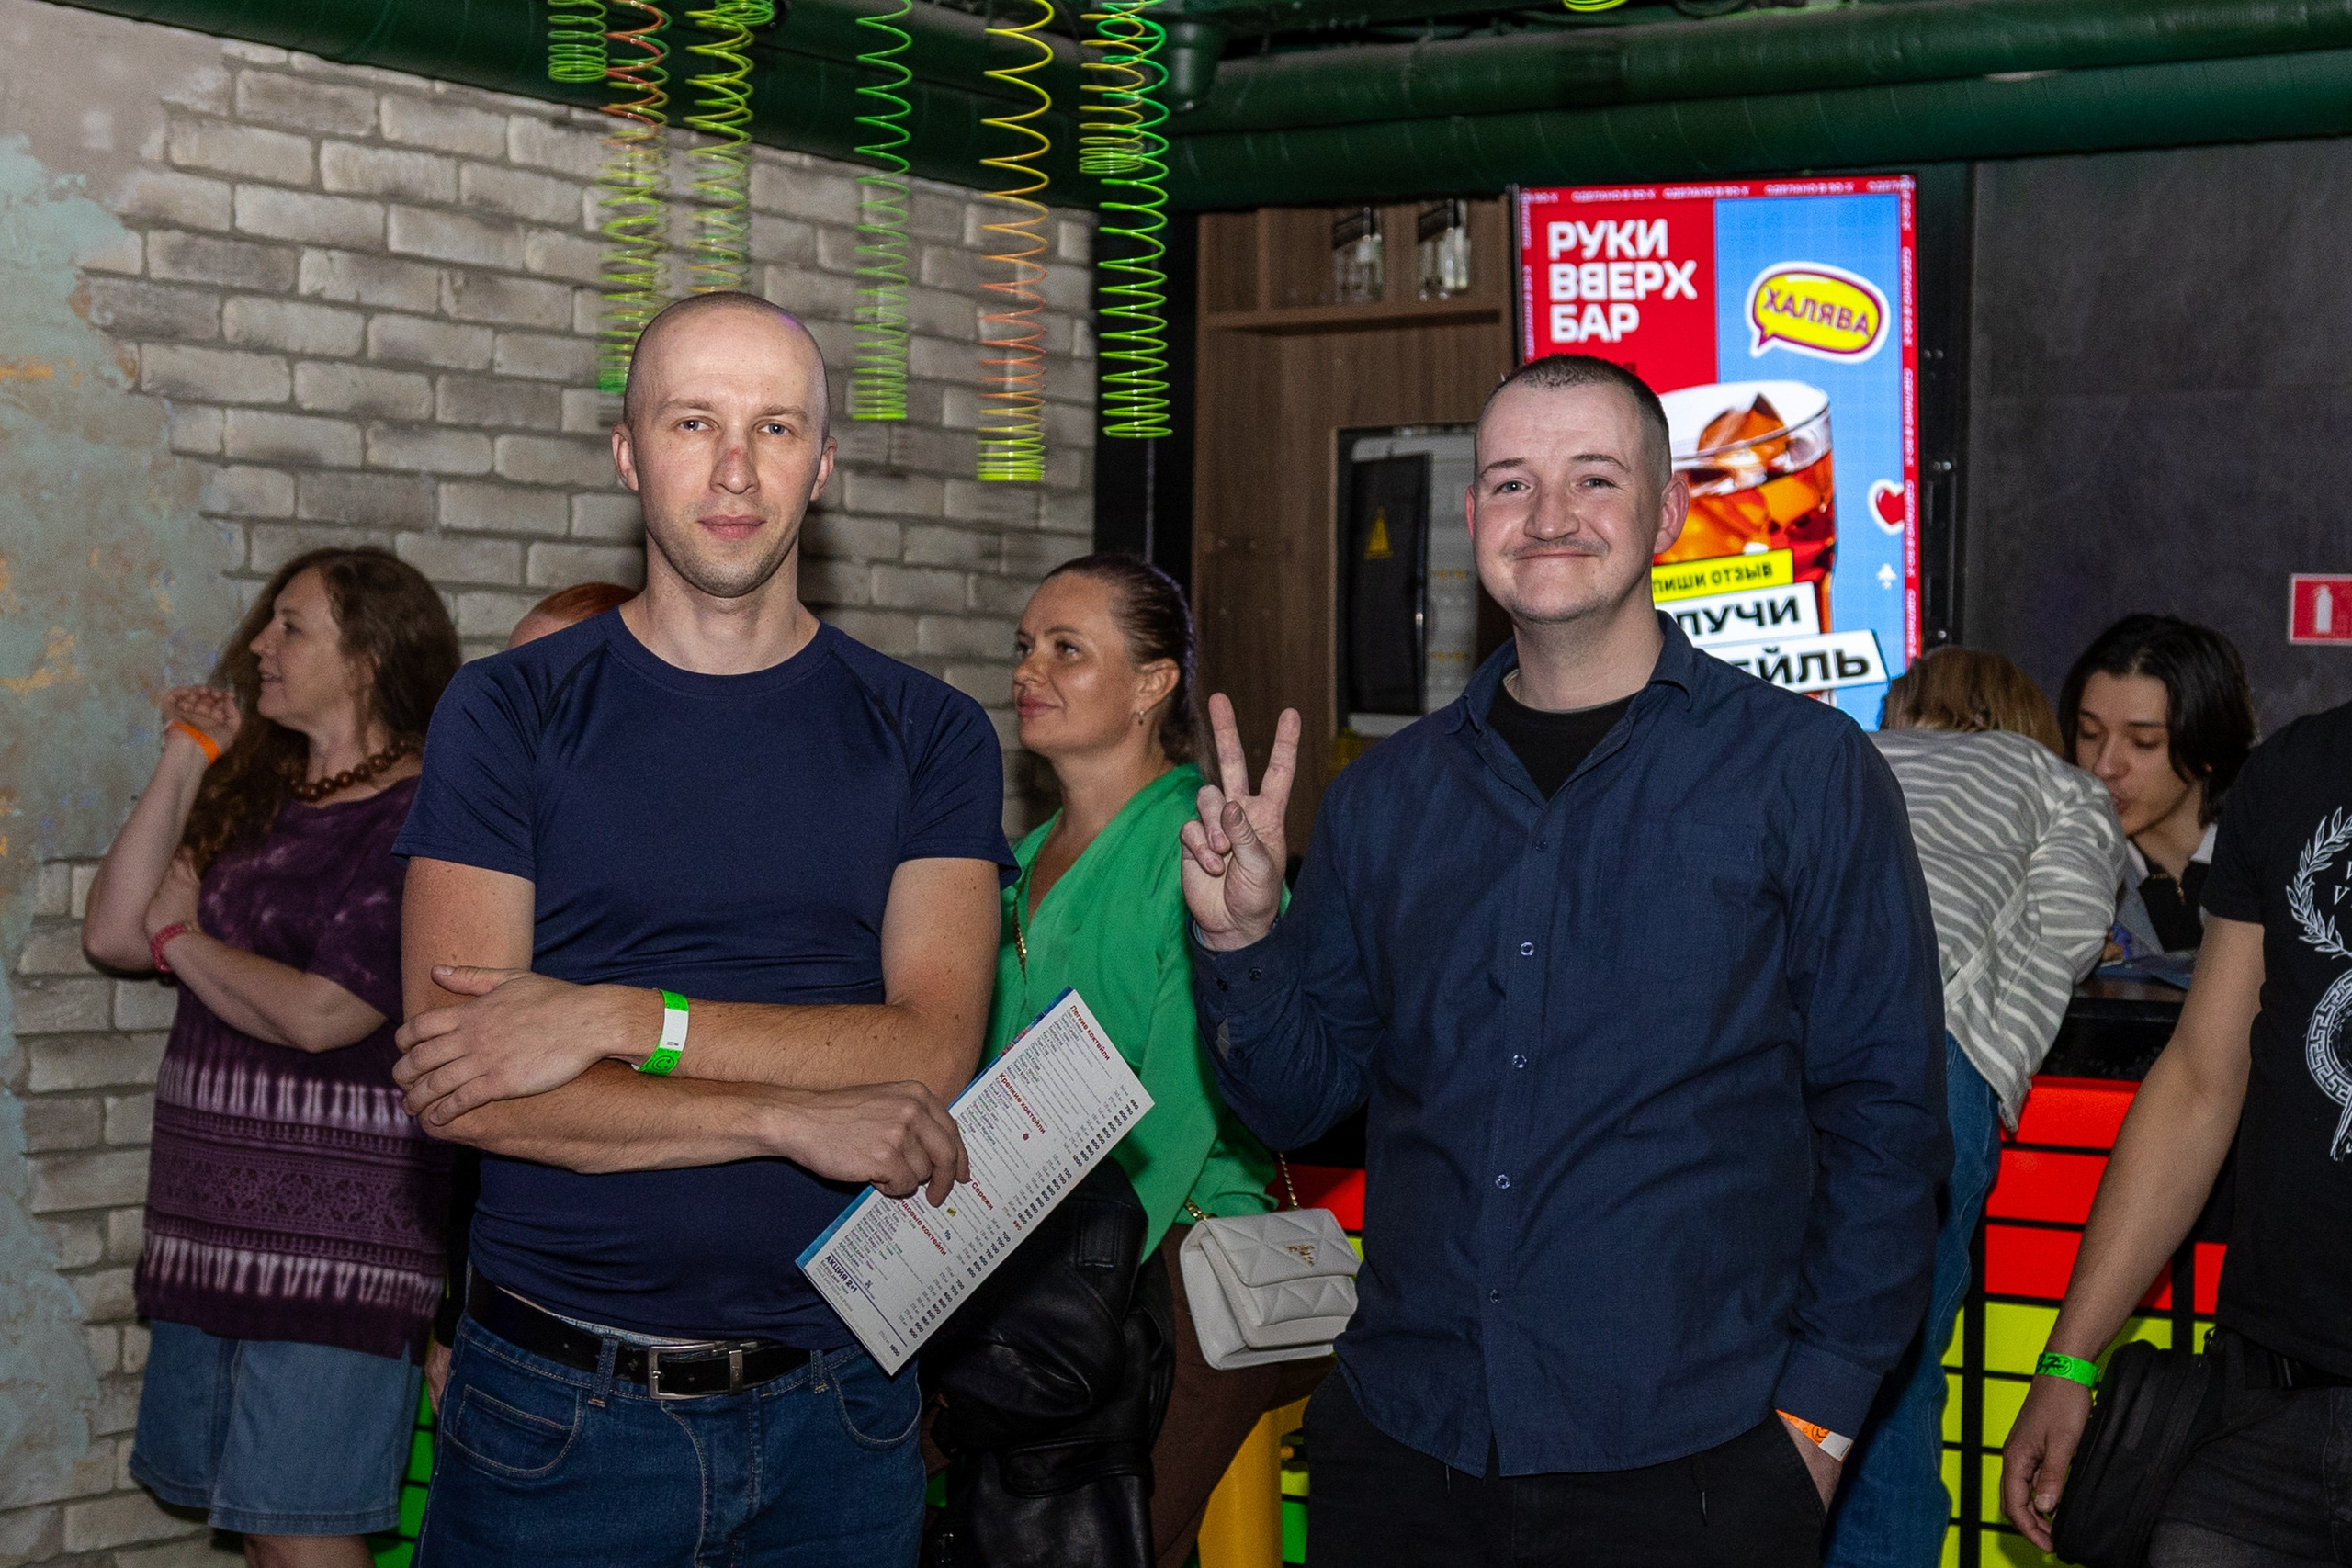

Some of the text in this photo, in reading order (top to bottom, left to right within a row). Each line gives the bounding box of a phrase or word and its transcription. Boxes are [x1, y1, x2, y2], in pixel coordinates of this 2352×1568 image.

[1547, 218, 1669, 259] РУКИ
[1549, 260, 1698, 301] ВВЕРХ
[1549, 303, 1640, 344] БАР
[1763, 285, 1871, 337] ХАЛЯВА
[1710, 561, 1774, 586] ОТЗЫВ
[1069, 1003, 1090, 1031] Легкие
[1085, 1026, 1112, 1062] коктейли
[997, 1071, 1023, 1105] Крепкие
[1019, 1100, 1047, 1135] коктейли
[969, 1180, 995, 1212] Сережи
[920, 1222, 948, 1258] коктейли
[823, 1252, 849, 1282] АКЦИЯ
[844, 1278, 858, 1294] 2+1
